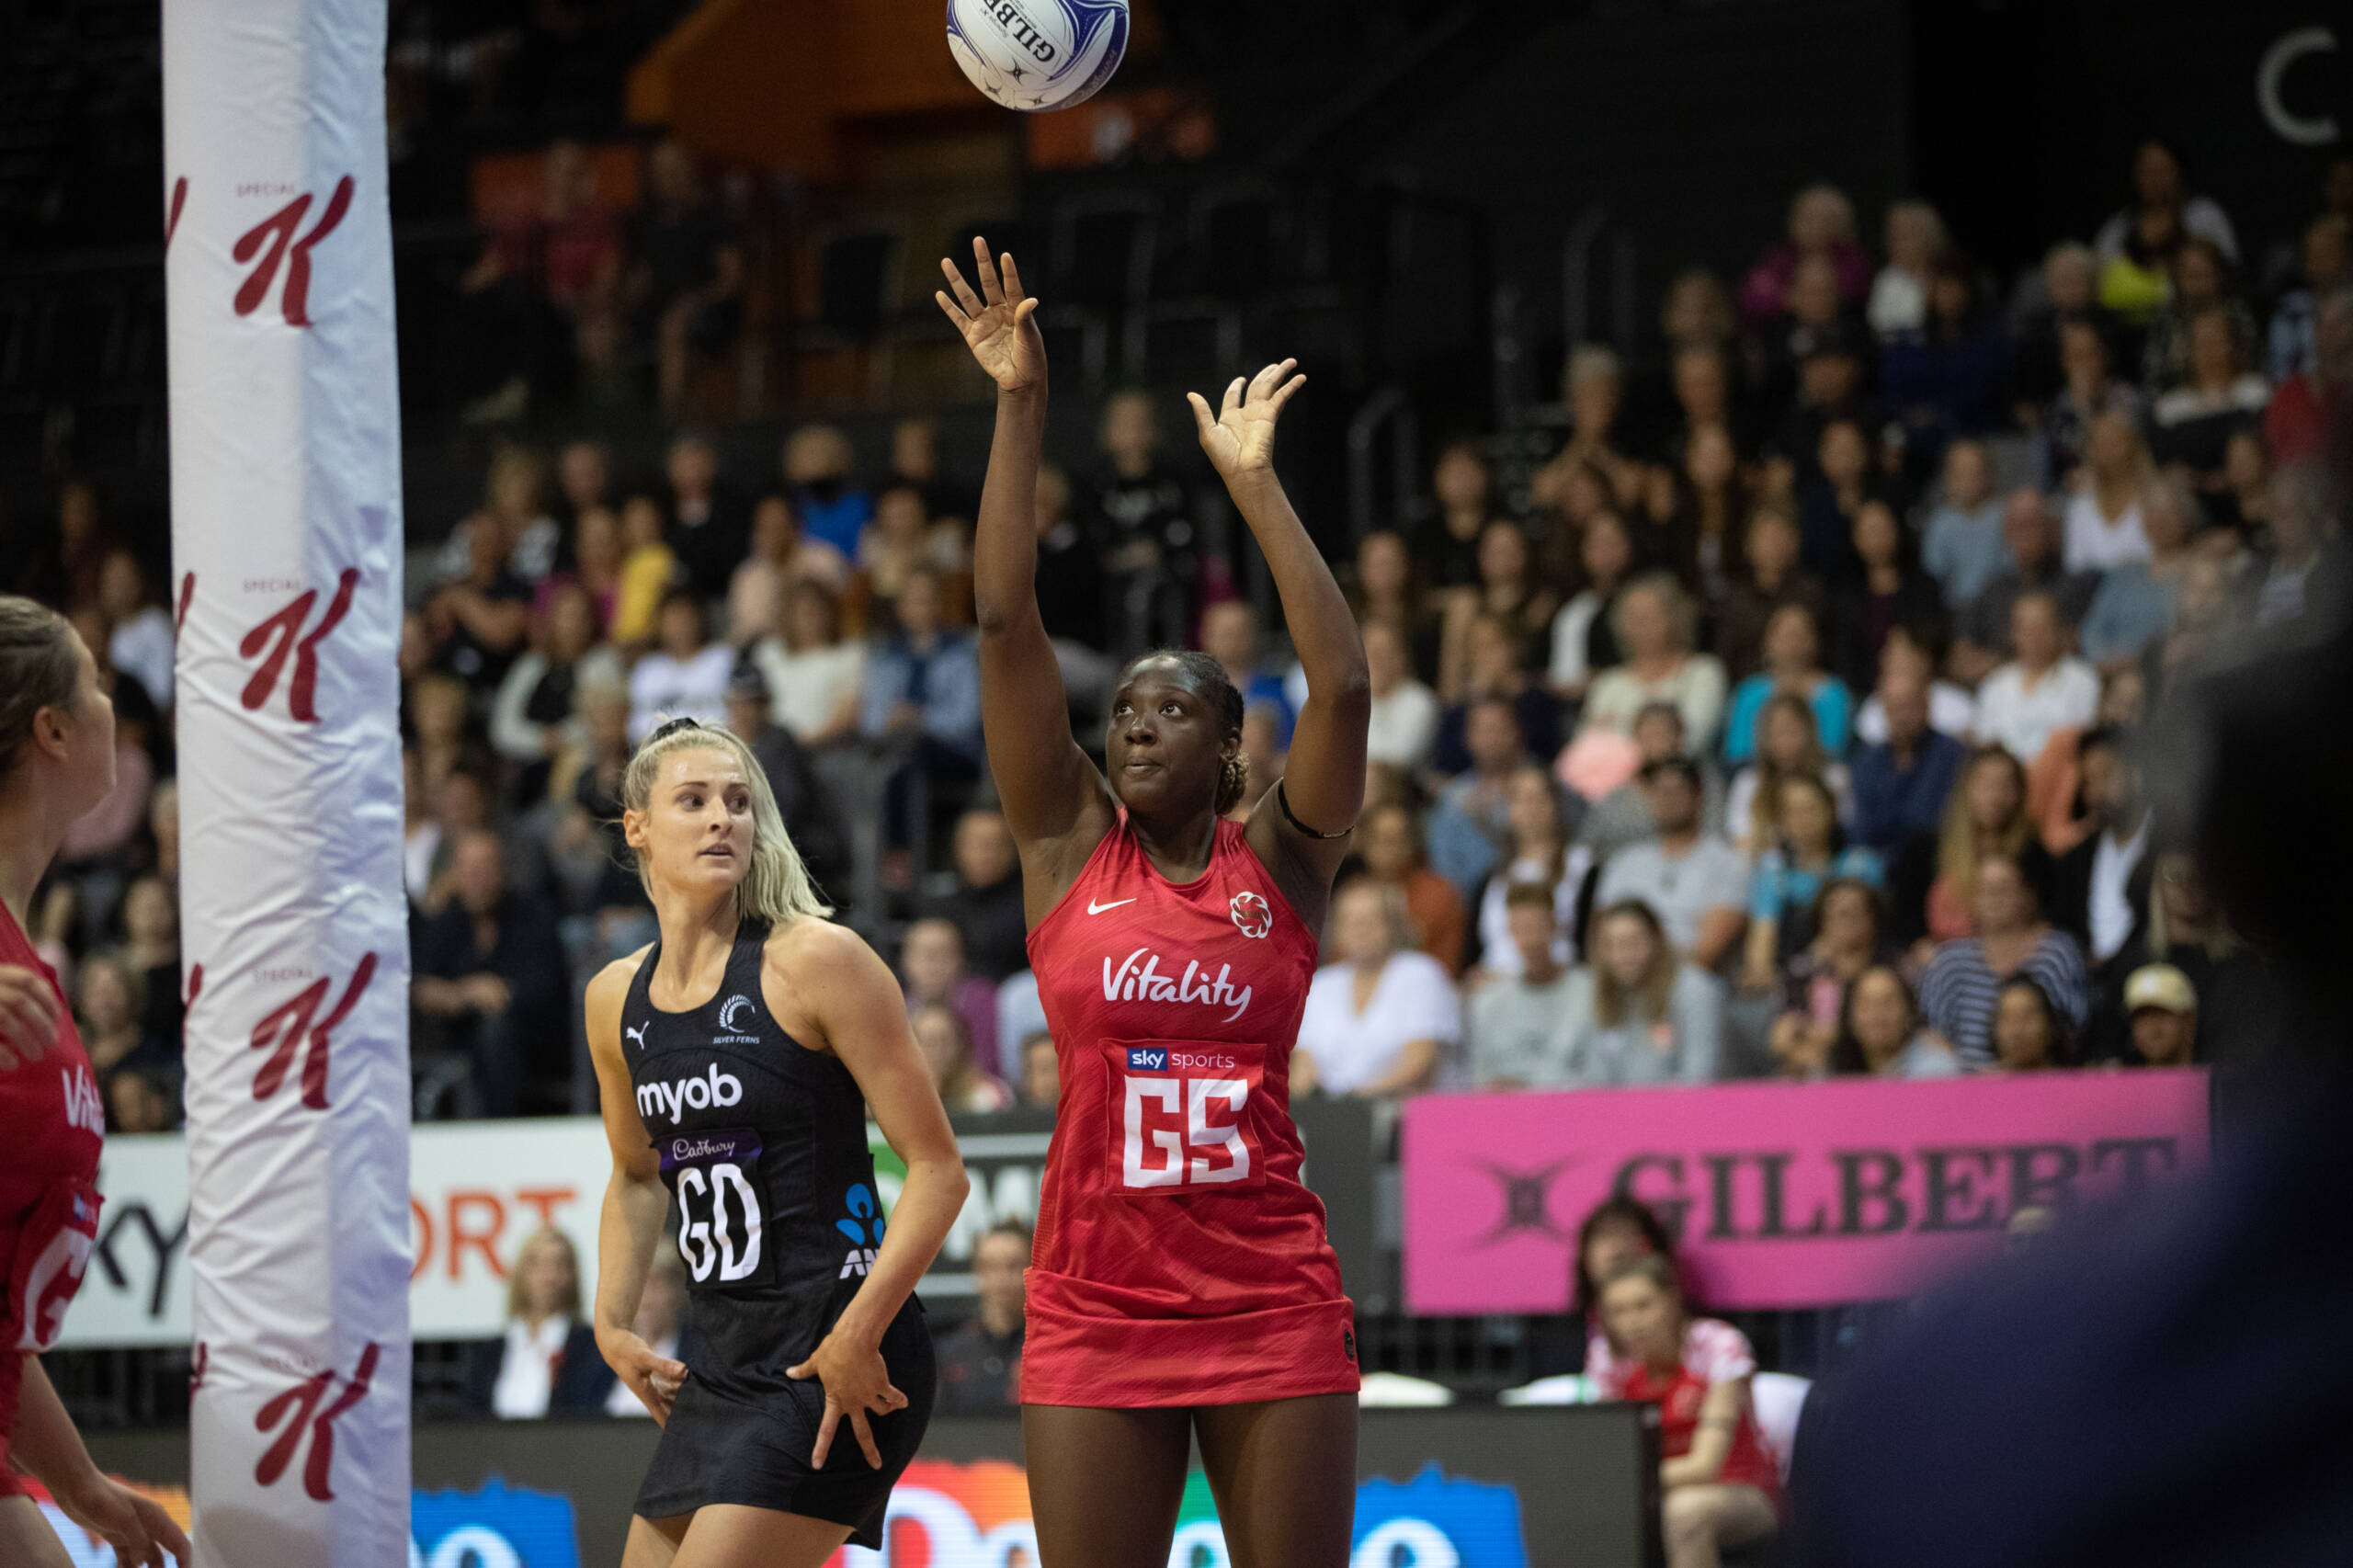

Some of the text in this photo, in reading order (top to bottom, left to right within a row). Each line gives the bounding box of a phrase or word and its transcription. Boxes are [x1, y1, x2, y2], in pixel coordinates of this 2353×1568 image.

[2256, 28, 2340, 144] C
[236, 184, 295, 198] SPECIAL
[233, 173, 356, 329] K
[239, 568, 360, 723] K
[250, 951, 379, 1111] K
[712, 1036, 761, 1045] SILVER FERNS
[1103, 948, 1252, 1023] Vitality
[637, 1062, 743, 1125] myob
[1131, 1050, 1235, 1070] sky sports
[672, 1139, 735, 1161] Cadbury
[1123, 1075, 1249, 1187] GS
[677, 1164, 762, 1283] GD
[254, 1341, 380, 1503] K
